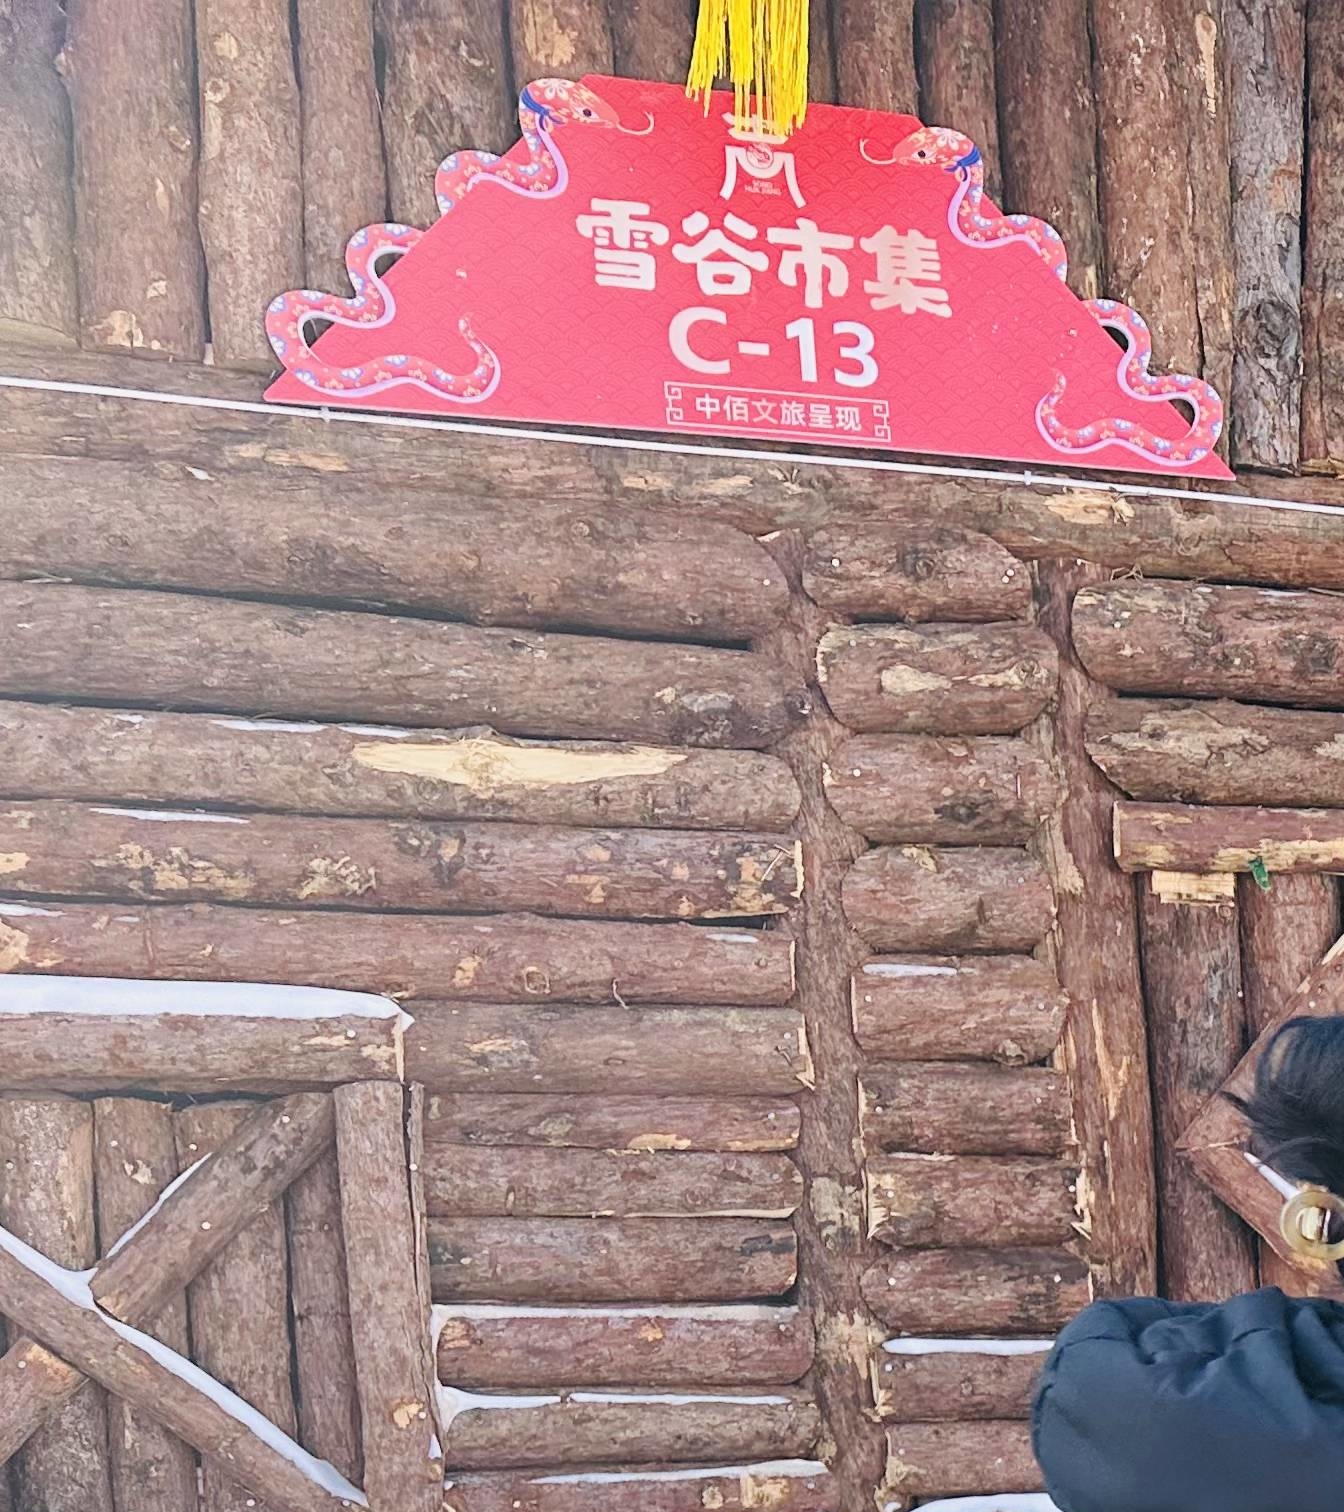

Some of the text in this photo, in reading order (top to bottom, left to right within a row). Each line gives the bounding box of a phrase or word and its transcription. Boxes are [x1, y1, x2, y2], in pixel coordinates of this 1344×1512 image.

[575, 198, 953, 318] 雪谷市集
[667, 306, 879, 388] C-13
[694, 393, 862, 432] 中佰文旅呈现
